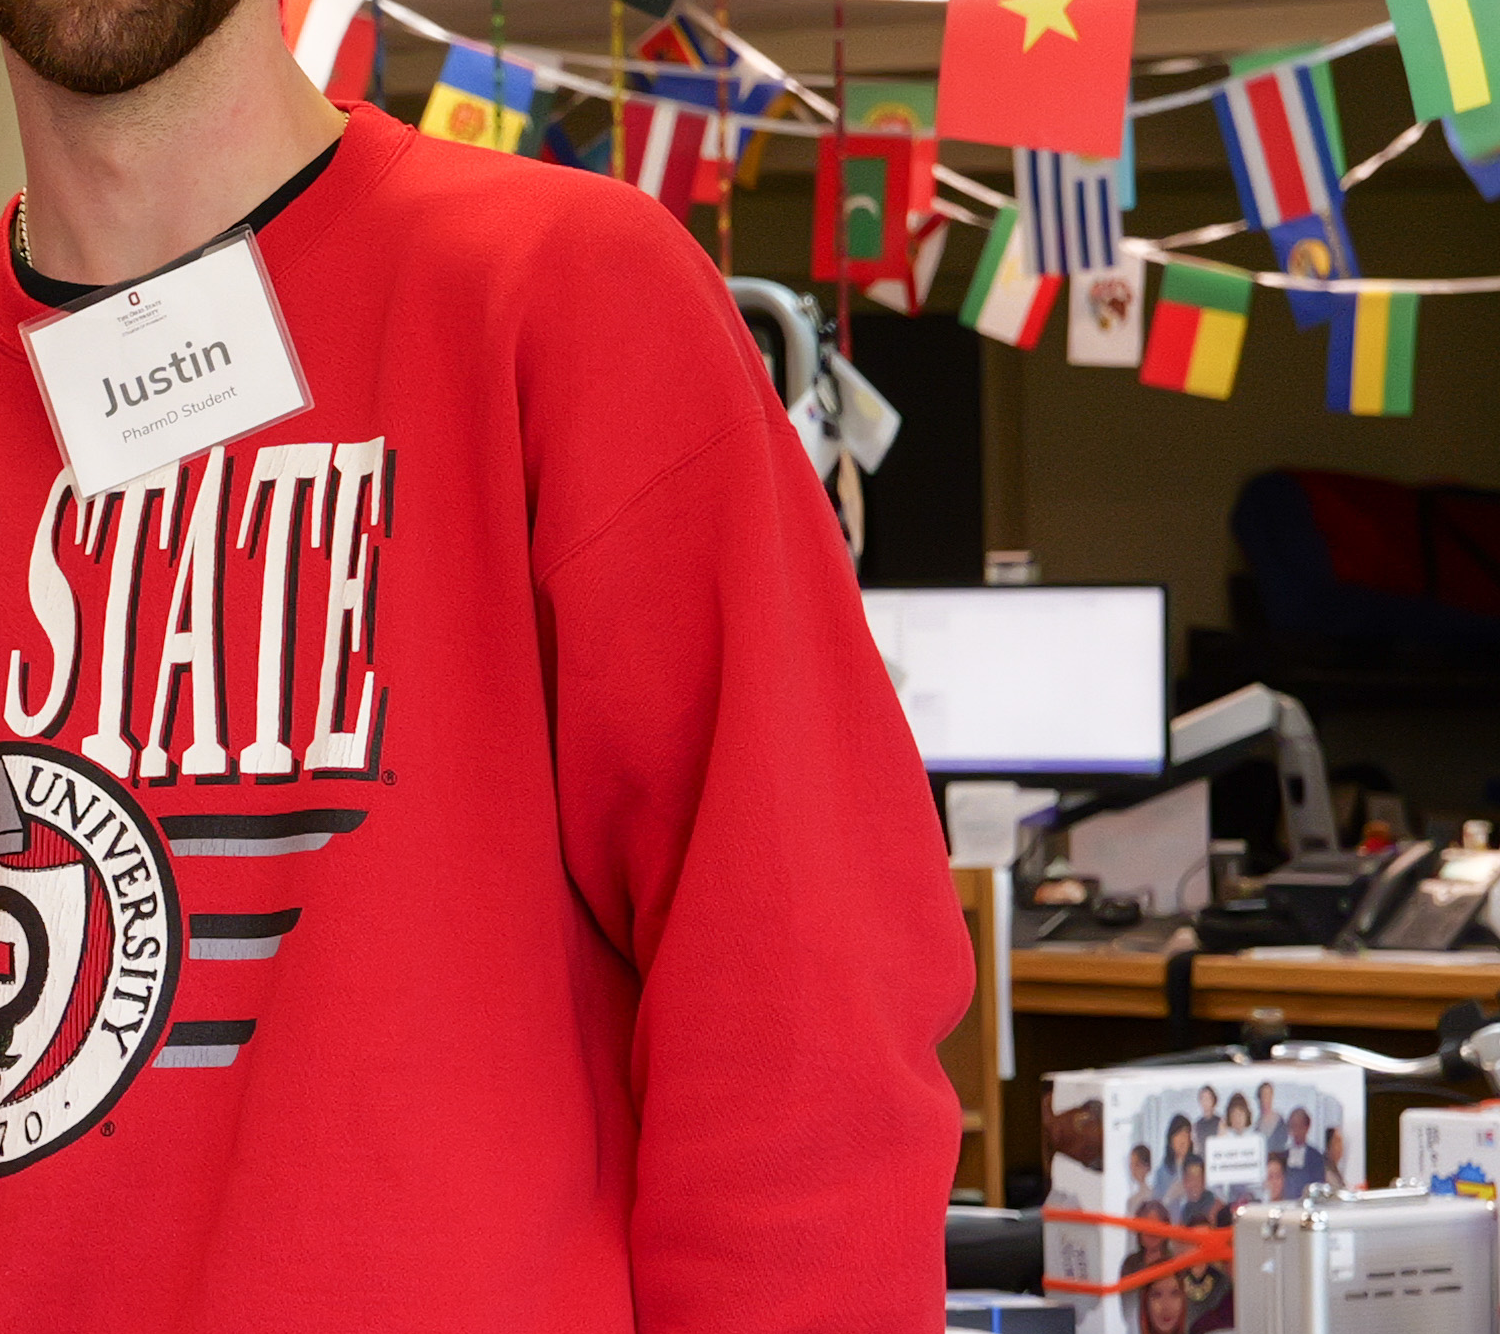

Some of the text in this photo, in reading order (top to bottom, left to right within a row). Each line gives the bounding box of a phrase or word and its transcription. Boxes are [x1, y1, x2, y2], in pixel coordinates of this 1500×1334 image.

[102, 339, 232, 418] Justin
[122, 386, 238, 443] PharmD Student
[5, 436, 395, 785] STATE
[24, 768, 162, 1062] UNIVERSITY
